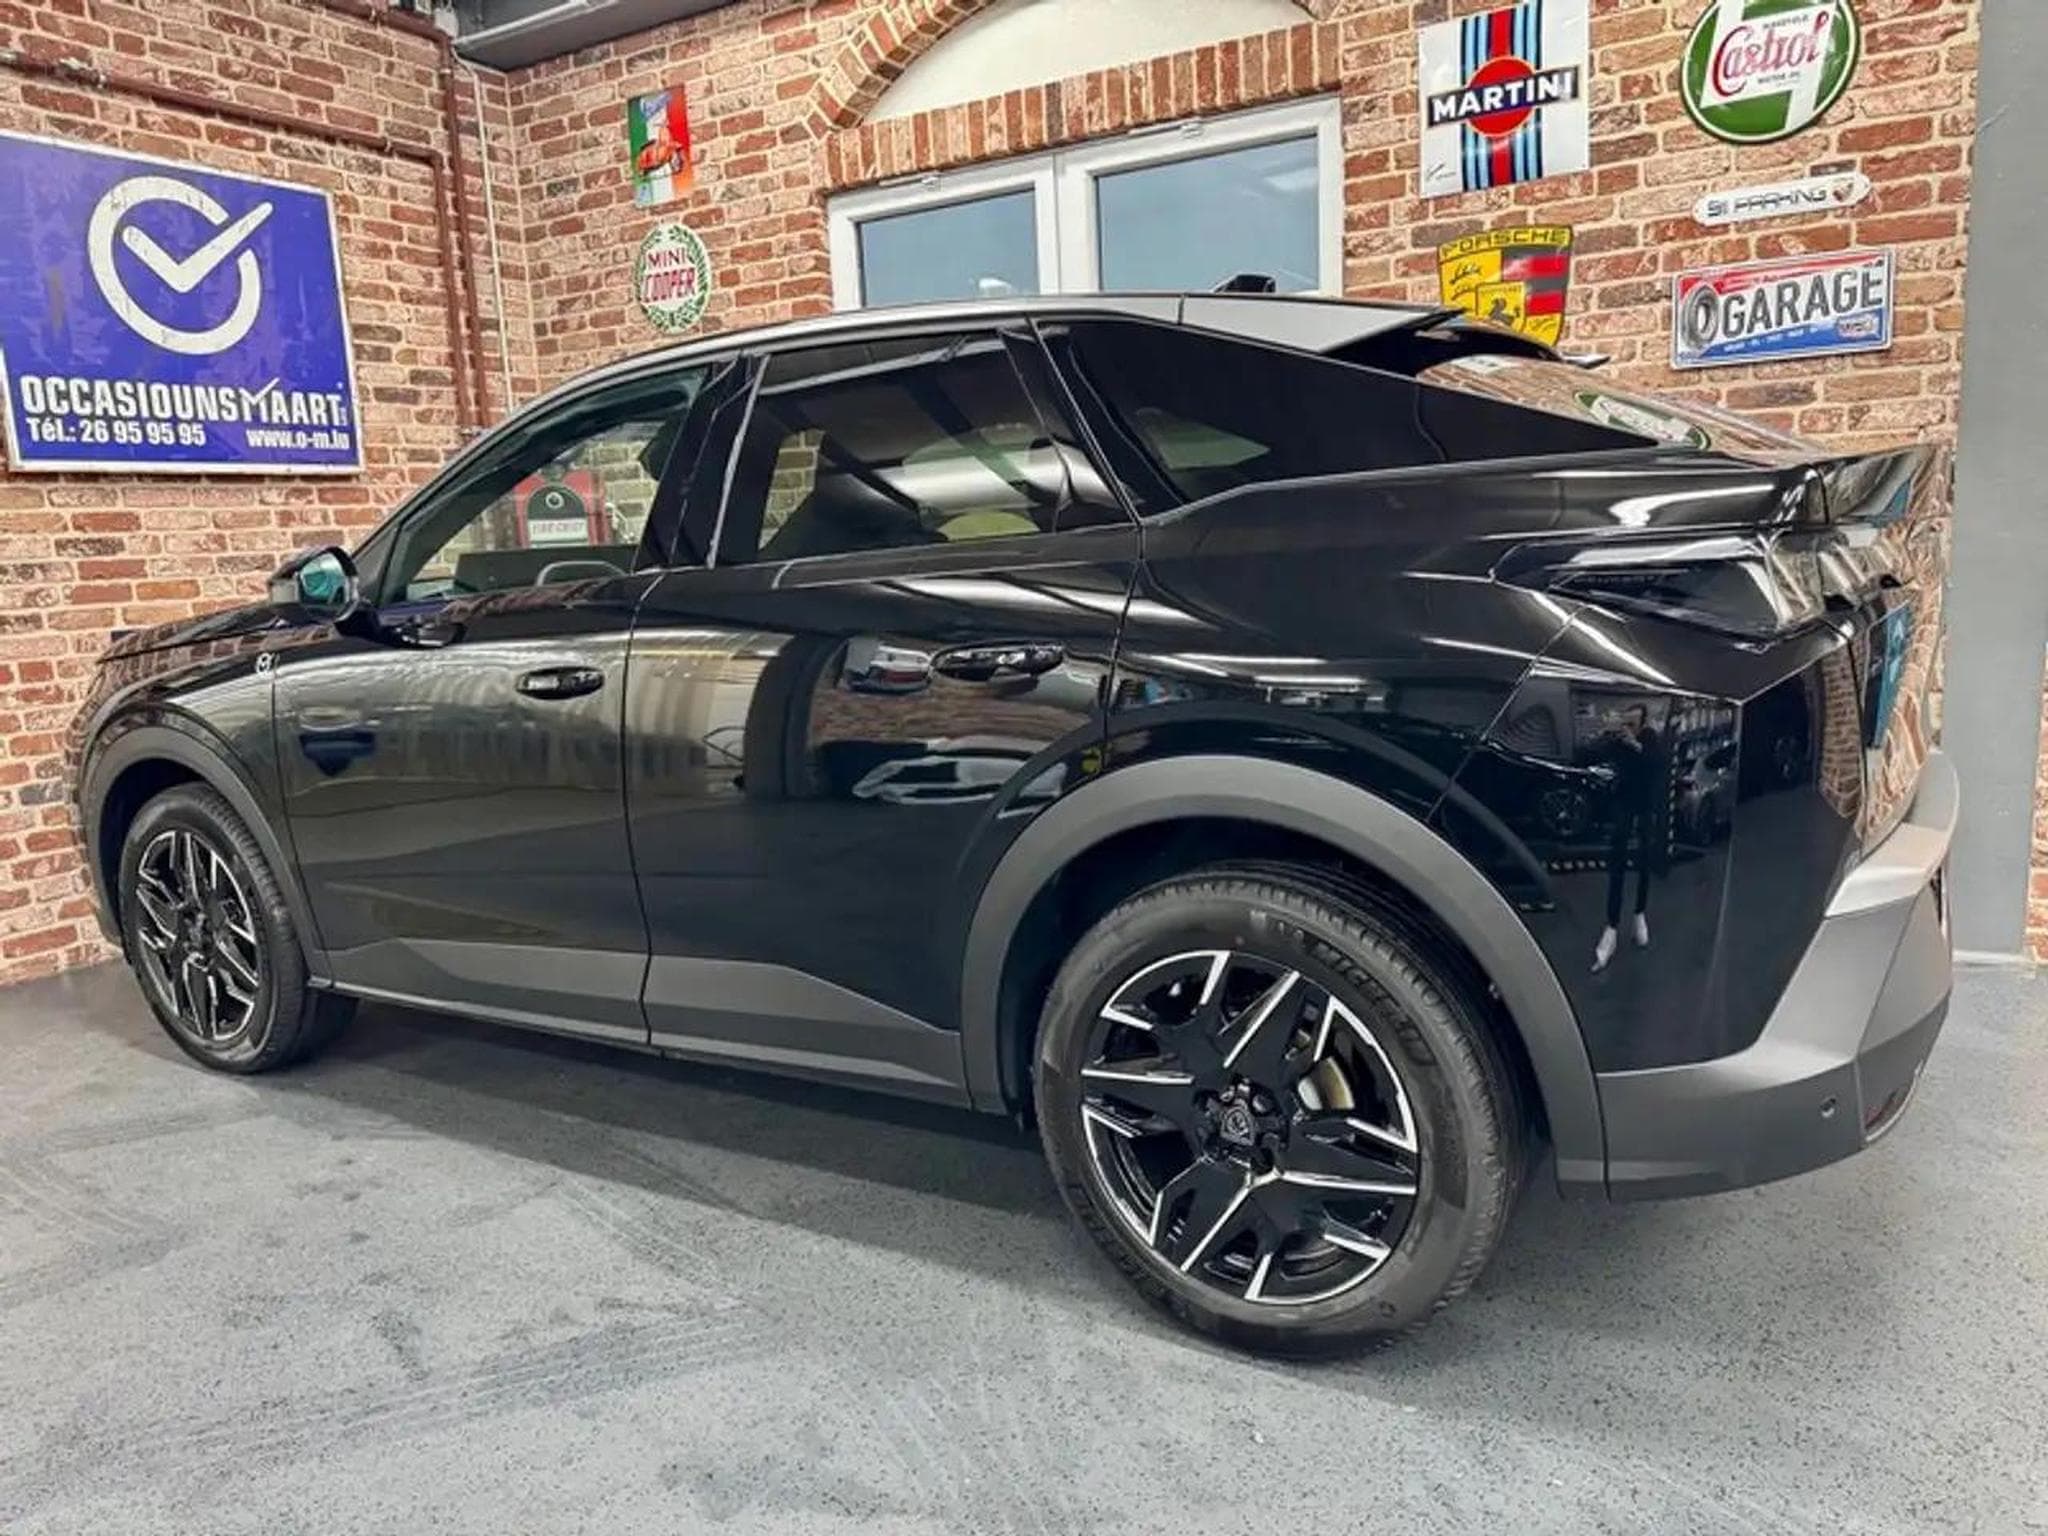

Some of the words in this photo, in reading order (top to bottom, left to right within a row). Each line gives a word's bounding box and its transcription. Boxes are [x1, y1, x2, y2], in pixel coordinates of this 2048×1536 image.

[1712, 10, 1829, 97] Castrol
[1432, 70, 1573, 123] MARTINI
[647, 247, 686, 269] MINI
[1442, 228, 1567, 258] PORSCHE
[643, 267, 696, 303] COOPER
[79, 419, 110, 443] 26
[113, 420, 143, 444] 95
[146, 422, 176, 446] 95
[177, 423, 207, 447] 95
[245, 429, 350, 450] www.o-m.lu
